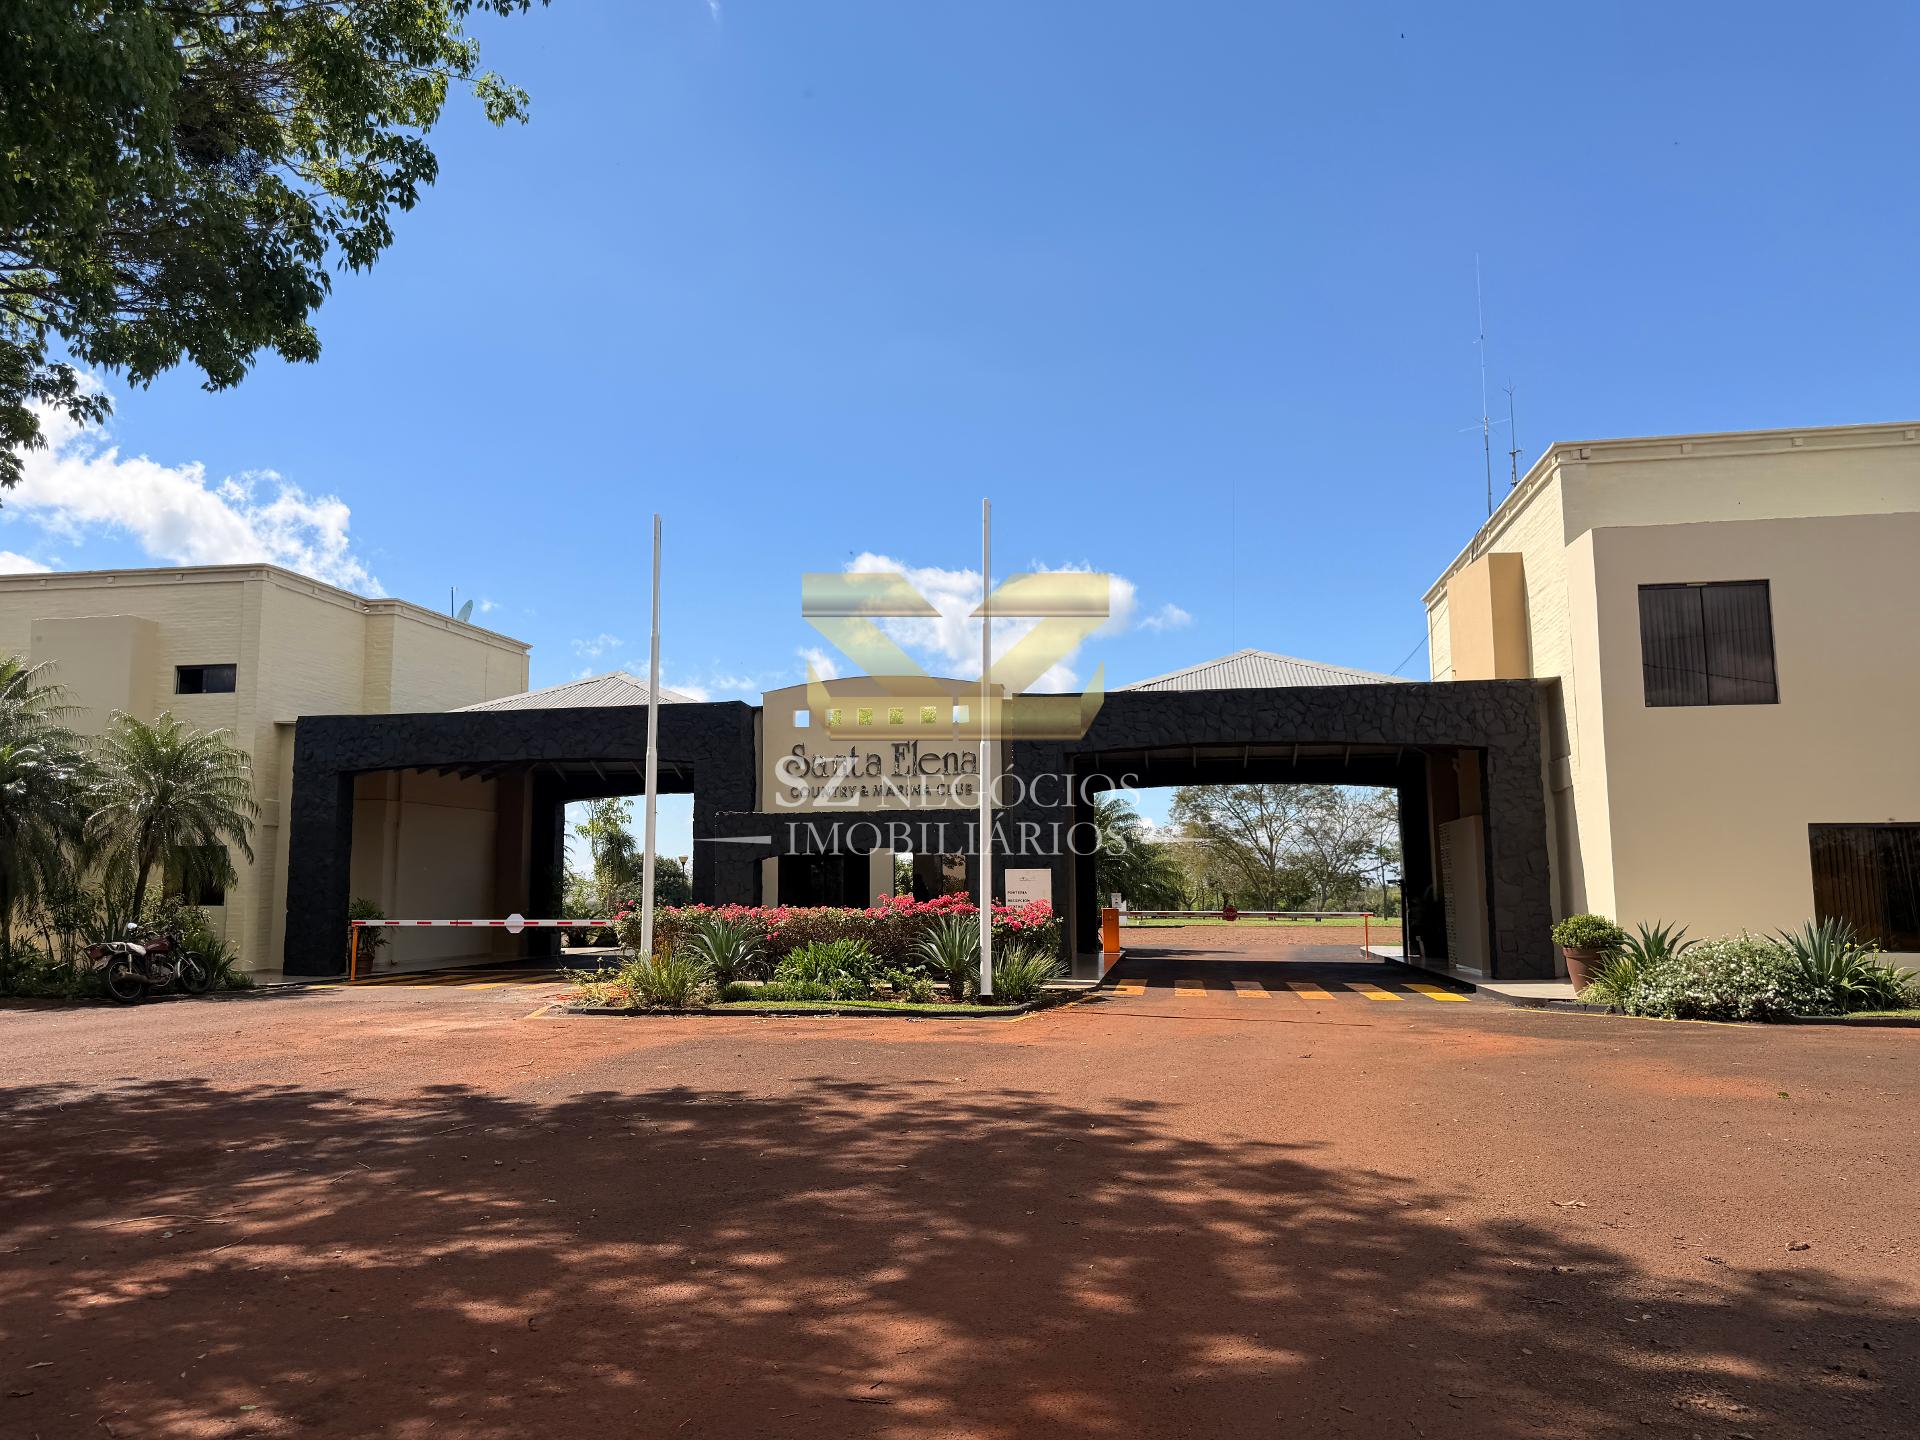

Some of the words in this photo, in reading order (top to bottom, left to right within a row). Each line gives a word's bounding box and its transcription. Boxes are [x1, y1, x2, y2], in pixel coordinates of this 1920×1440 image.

[786, 742, 882, 778] Santa
[891, 739, 980, 776] Elena
[790, 785, 856, 798] COUNTRY
[861, 785, 869, 797] &
[873, 784, 931, 797] MARINA
[936, 783, 973, 796] CLUB
